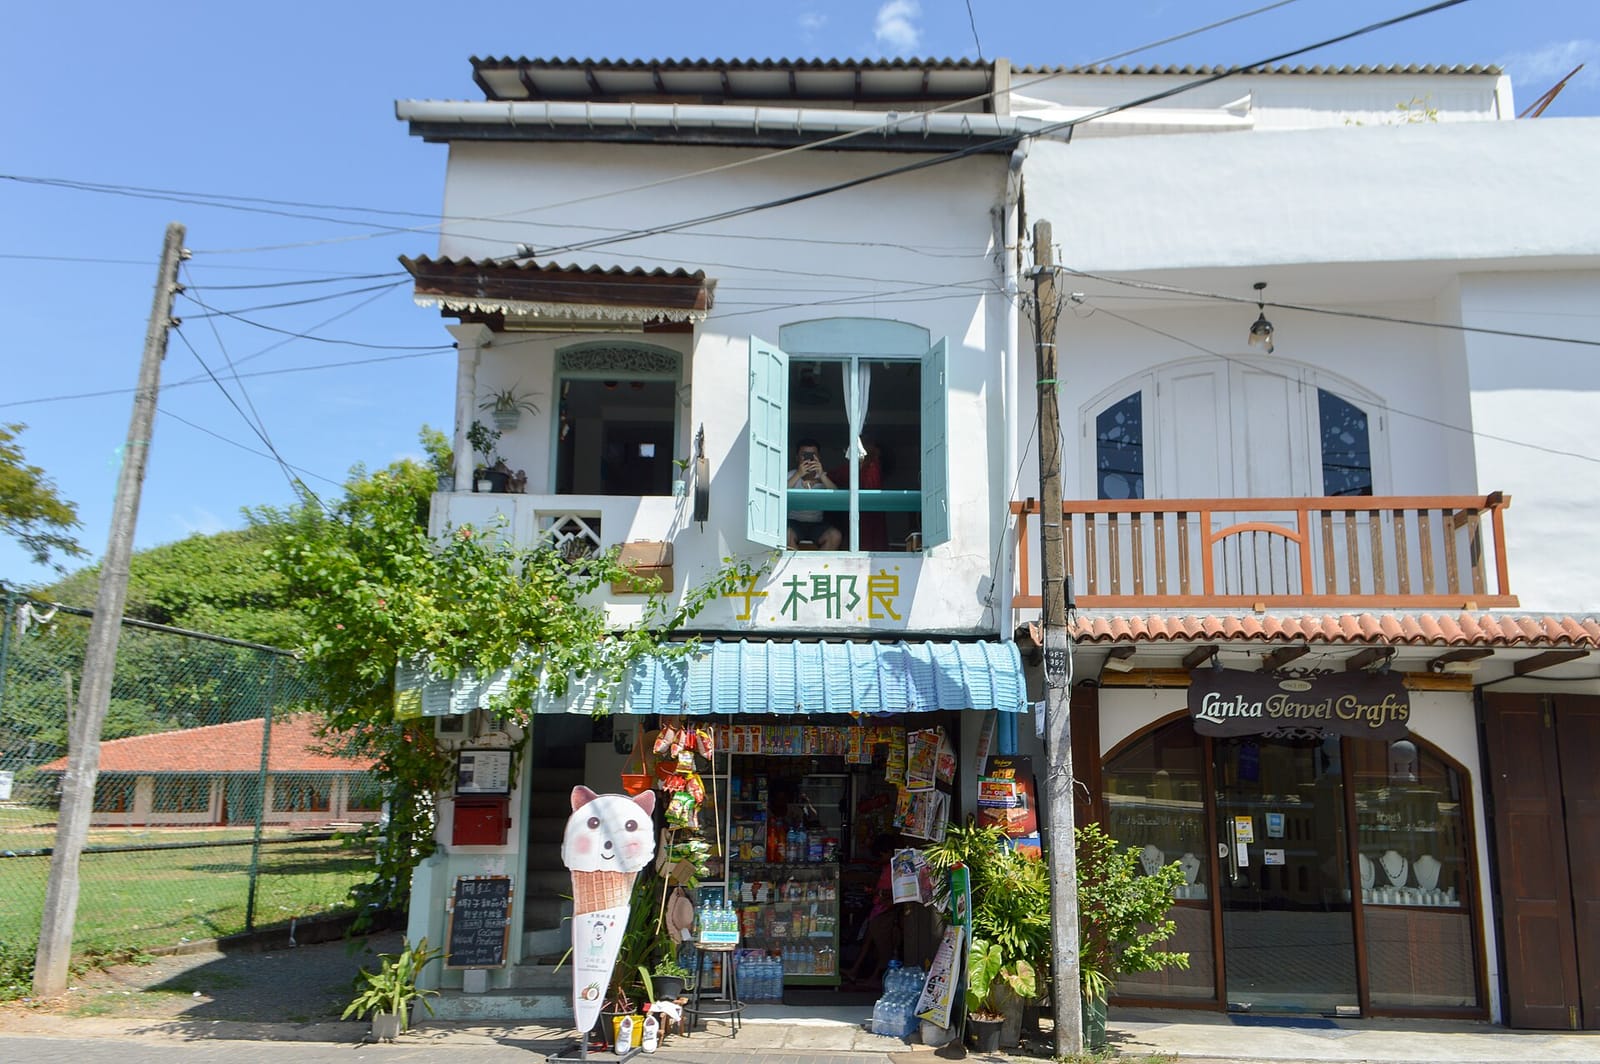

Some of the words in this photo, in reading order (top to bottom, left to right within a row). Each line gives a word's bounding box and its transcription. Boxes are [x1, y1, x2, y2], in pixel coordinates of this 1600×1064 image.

[1195, 692, 1264, 724] Lanka
[1265, 694, 1332, 720] Jewel
[1335, 694, 1408, 728] Crafts
